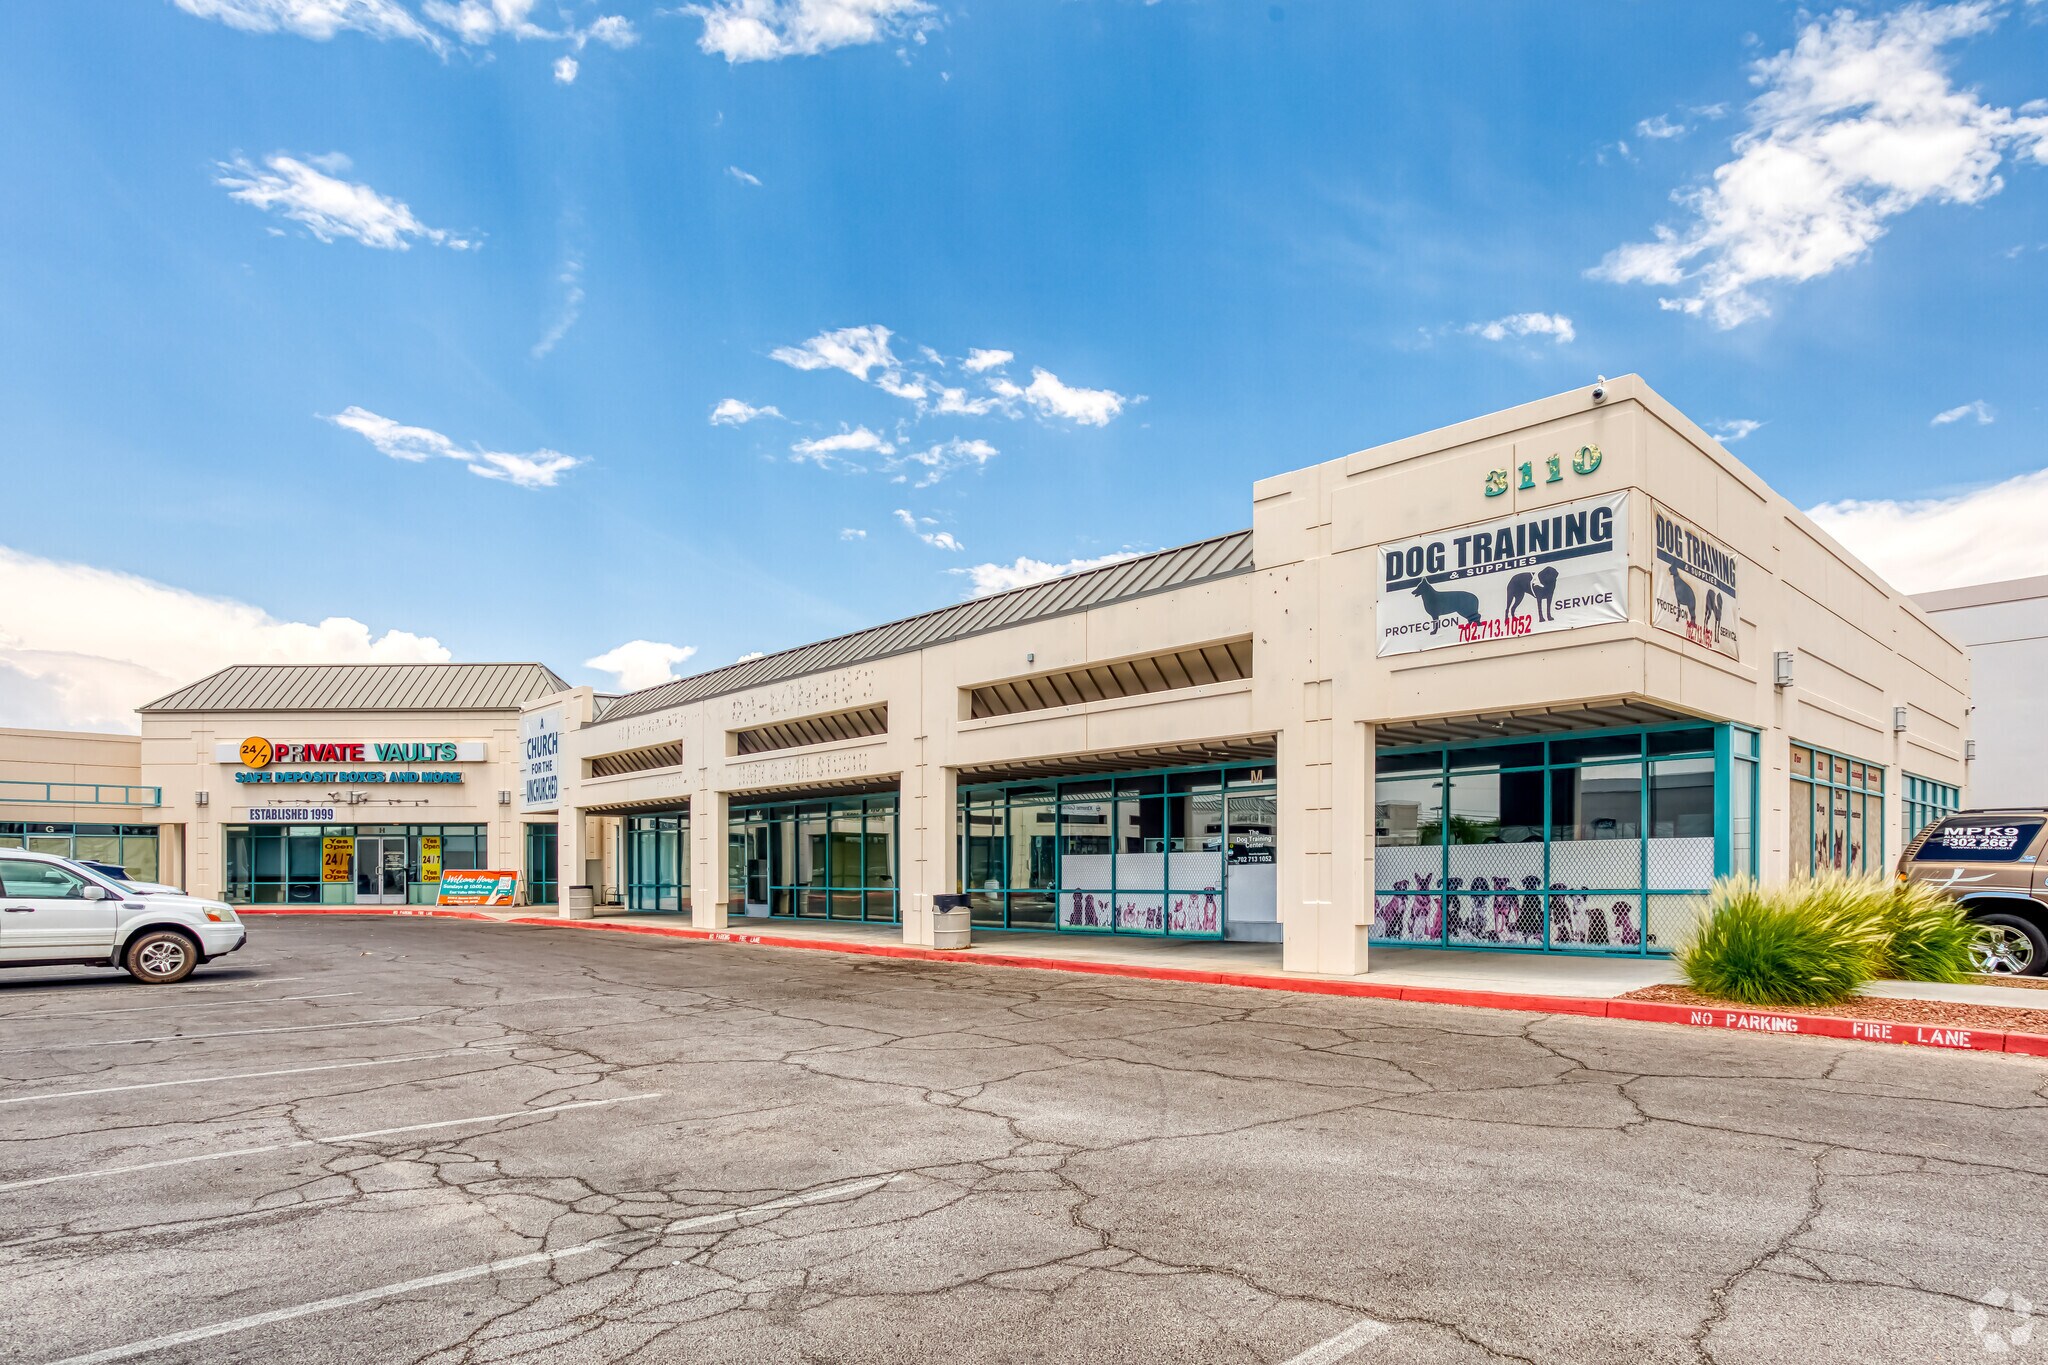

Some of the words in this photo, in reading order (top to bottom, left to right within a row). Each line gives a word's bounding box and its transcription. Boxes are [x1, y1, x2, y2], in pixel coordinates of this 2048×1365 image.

[1485, 443, 1603, 497] 3110
[1386, 541, 1446, 582] DOG
[1453, 506, 1613, 568] TRAINING
[1656, 514, 1683, 559] DOG
[1685, 530, 1736, 588] TRAINING
[1450, 571, 1459, 580] &
[1466, 556, 1537, 577] SUPPLIES
[1691, 568, 1717, 586] SUPPLIES
[1555, 592, 1613, 611] SERVICE
[1385, 617, 1459, 637] PROTECTION
[1458, 615, 1532, 642] 702.713.1052
[540, 717, 544, 729] A
[242, 745, 267, 764] 24/7
[275, 743, 365, 762] PRIVATE
[374, 742, 457, 762] VAULTS
[527, 732, 558, 760] CHURCH
[532, 763, 541, 774] FOR
[542, 760, 552, 773] THE
[235, 771, 272, 783] SAFE
[275, 771, 338, 783] DEPOSIT
[339, 771, 386, 783] BOXES
[389, 771, 420, 783] AND
[421, 771, 462, 783] MORE
[1250, 769, 1263, 784] M
[527, 775, 557, 803] UNCHURCHED
[249, 808, 308, 820] ESTABLISHED
[310, 808, 334, 820] 1999
[1816, 803, 1825, 815] Dog
[45, 825, 54, 833] G
[1944, 827, 2019, 836] MPK9
[1236, 836, 1248, 844] Dog
[1950, 838, 1976, 847] 302
[1980, 838, 2018, 847] 2667
[1691, 1011, 1713, 1025] NO
[1726, 1013, 1798, 1032] PARKING
[1853, 1021, 1893, 1040] FIRE
[1917, 1027, 1972, 1048] LANE
